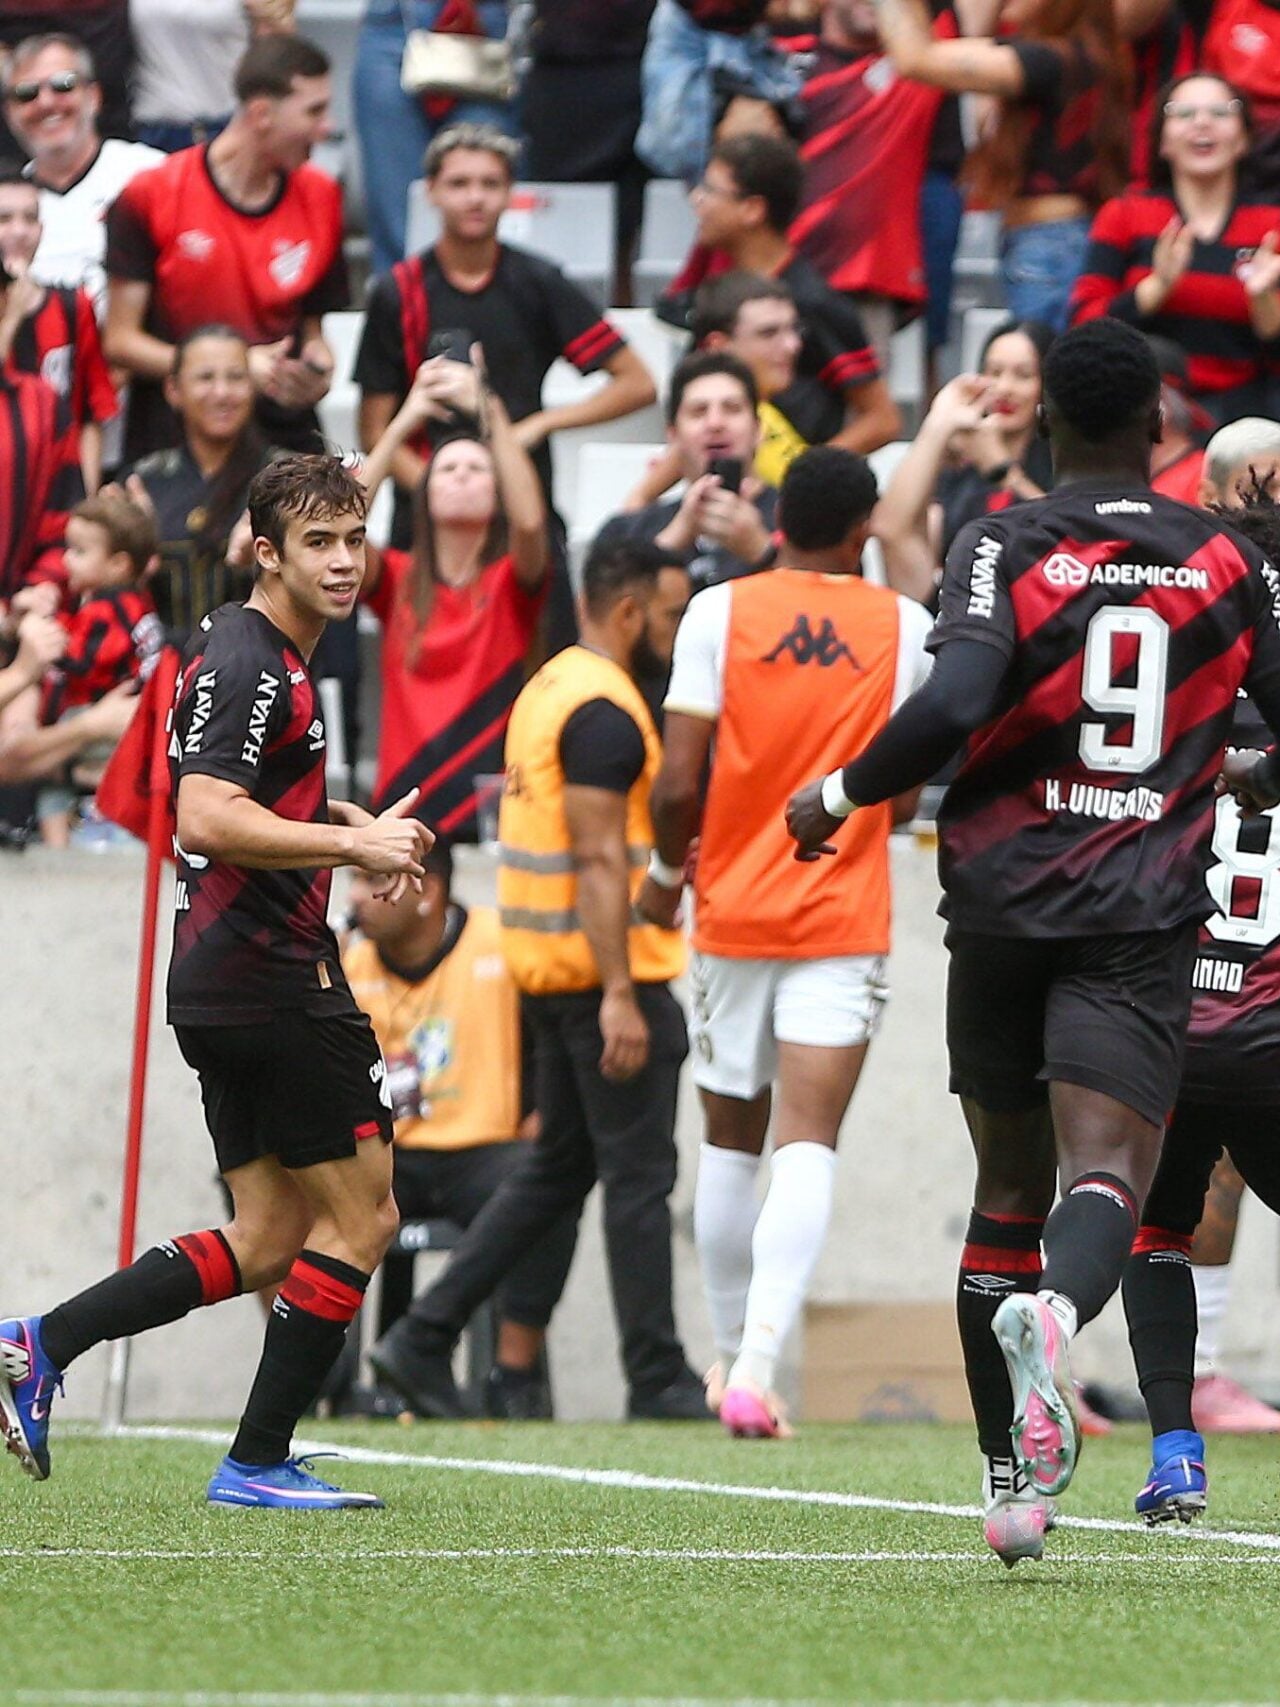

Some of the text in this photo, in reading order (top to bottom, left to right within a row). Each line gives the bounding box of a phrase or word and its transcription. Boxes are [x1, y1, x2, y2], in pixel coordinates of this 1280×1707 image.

[1094, 498, 1153, 516] umbro
[966, 534, 1004, 620] HAVAN
[1090, 564, 1208, 591] ADEMICON
[184, 669, 218, 754] HAVAN
[241, 670, 280, 767] HAVAN
[1078, 605, 1170, 774] 9
[1191, 957, 1245, 994] INHO
